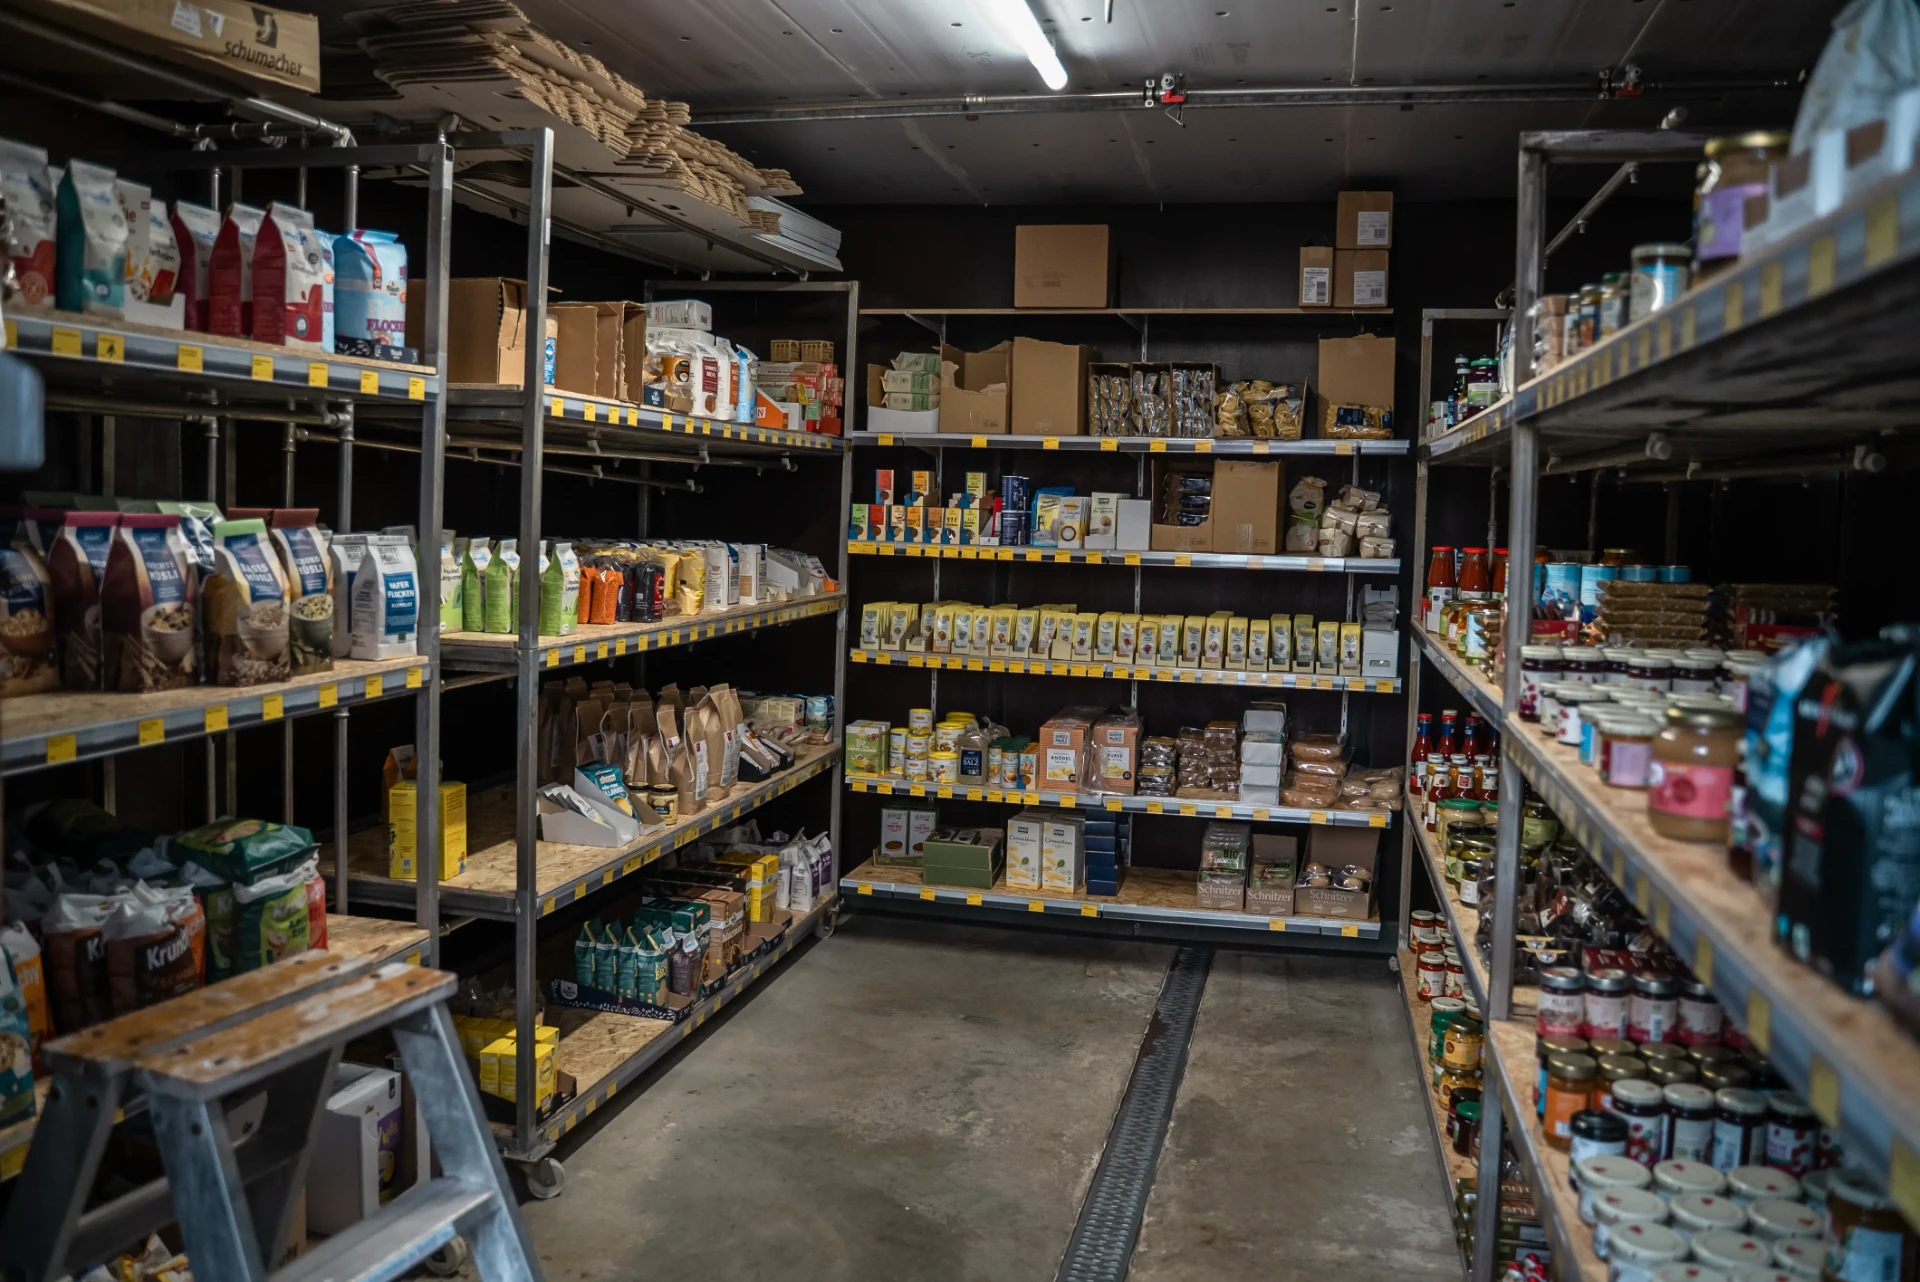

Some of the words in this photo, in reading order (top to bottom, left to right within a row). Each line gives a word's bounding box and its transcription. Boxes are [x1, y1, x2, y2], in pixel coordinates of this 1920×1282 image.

[223, 40, 302, 77] schumacher
[240, 563, 269, 573] BASIS
[387, 590, 415, 599] FLOCKEN
[1198, 884, 1242, 896] Schnitzer
[1247, 889, 1292, 902] Schnitzer
[1310, 889, 1354, 902] Schnitzer
[147, 927, 189, 970] Krun
